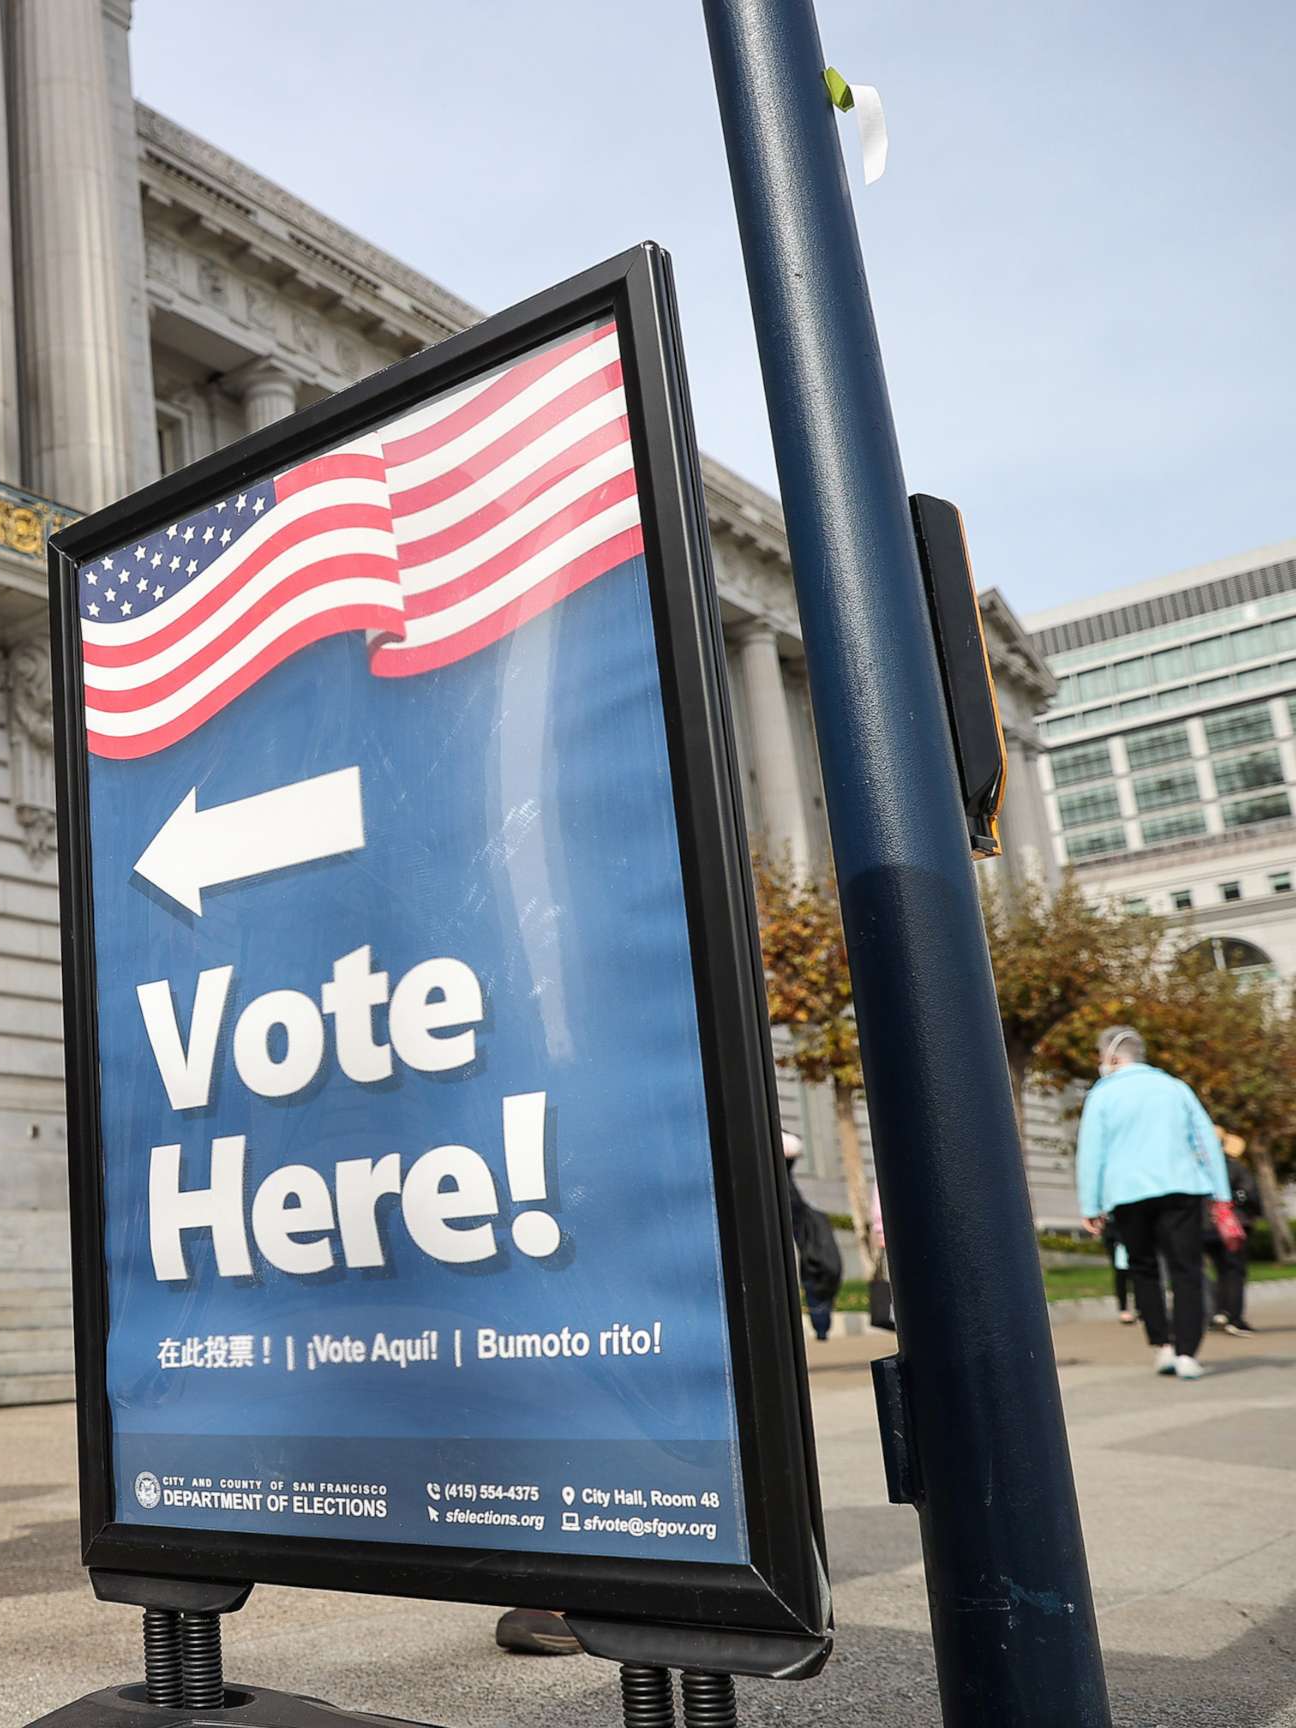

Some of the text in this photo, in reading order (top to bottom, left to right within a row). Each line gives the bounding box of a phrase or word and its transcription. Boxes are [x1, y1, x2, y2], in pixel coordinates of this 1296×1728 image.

[136, 945, 483, 1111] Vote
[148, 1091, 561, 1281] Here!
[307, 1330, 438, 1370] ¡Vote Aquí!
[477, 1322, 661, 1359] Bumoto rito!
[163, 1476, 387, 1495] CITY AND COUNTY OF SAN FRANCISCO
[445, 1483, 540, 1501] (415) 554-4375
[582, 1488, 720, 1508] City Hall, Room 48
[164, 1489, 263, 1511] DEPARTMENT
[267, 1494, 288, 1512] OF
[293, 1496, 387, 1517] ELECTIONS
[446, 1508, 544, 1530] sfelections.org
[583, 1515, 717, 1540] sfvote@sfgov.org
